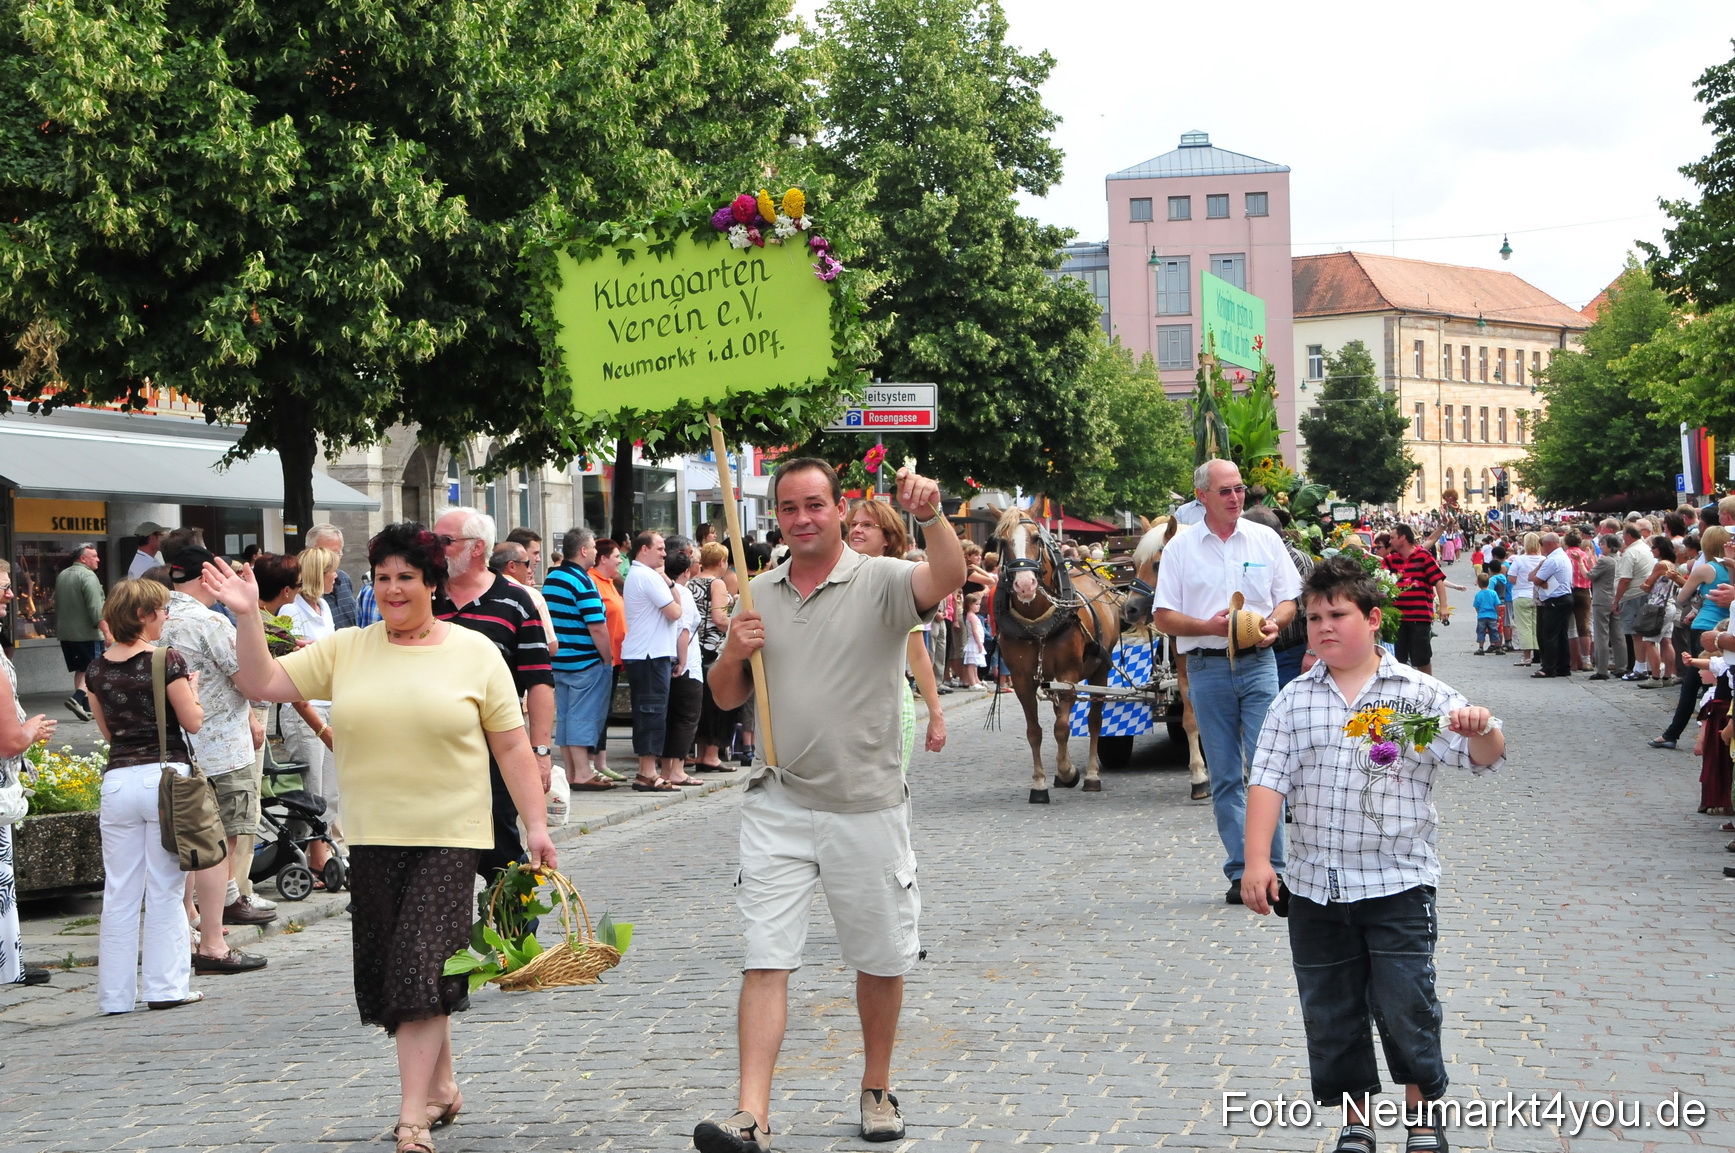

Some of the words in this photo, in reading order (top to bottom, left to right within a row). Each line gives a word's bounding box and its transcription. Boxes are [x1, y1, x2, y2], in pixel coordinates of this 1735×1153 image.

[593, 257, 773, 312] Kleingarten
[607, 304, 708, 344] Verein
[717, 286, 763, 327] e.V.
[602, 347, 697, 381] Neumarkt
[869, 412, 918, 425] Rosengasse
